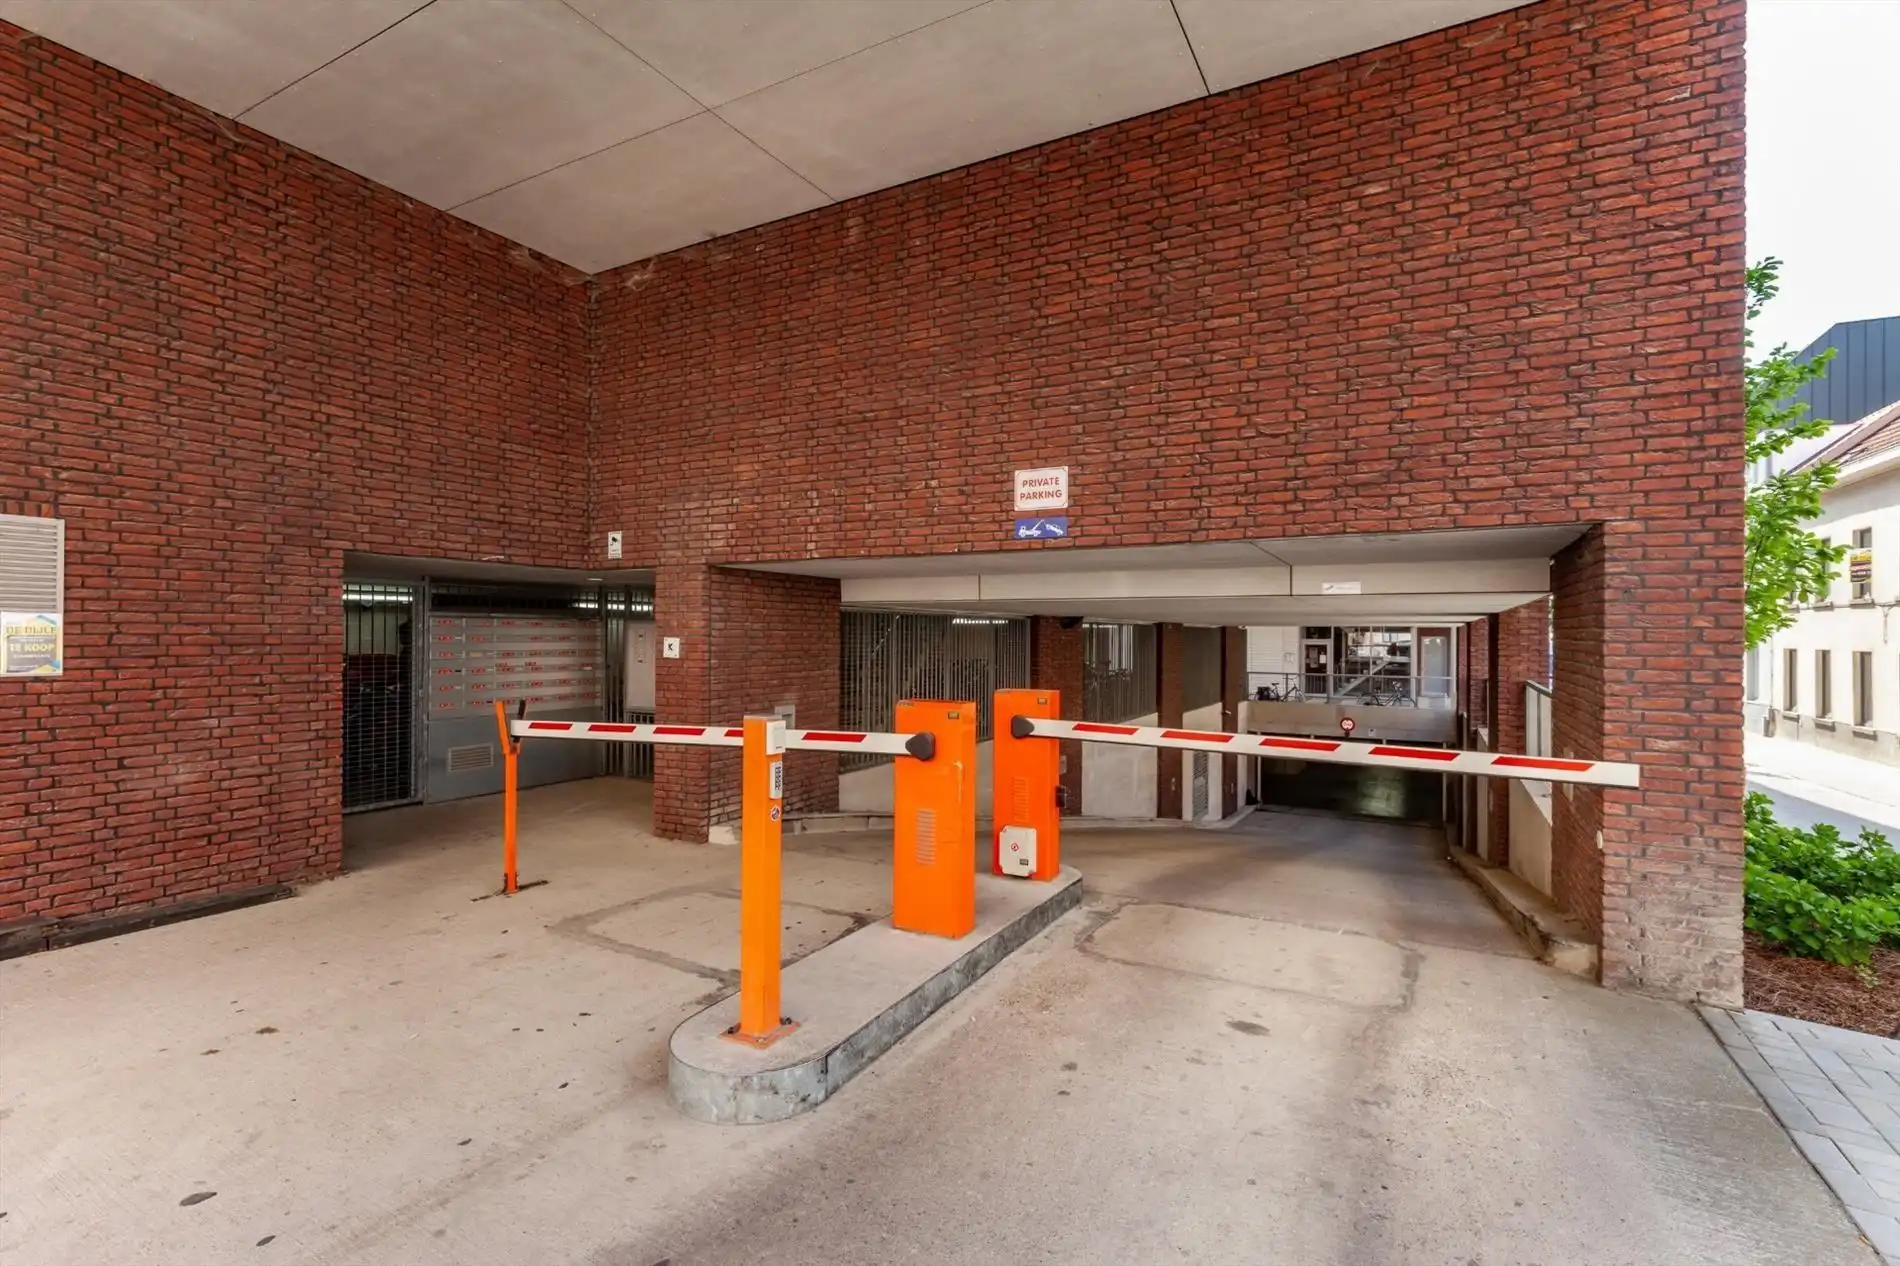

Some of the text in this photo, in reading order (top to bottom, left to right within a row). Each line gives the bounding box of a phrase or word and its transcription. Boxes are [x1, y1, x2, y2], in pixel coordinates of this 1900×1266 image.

[1022, 477, 1060, 488] PRIVATE
[1019, 490, 1063, 501] PARKING
[25, 643, 55, 652] KOOP
